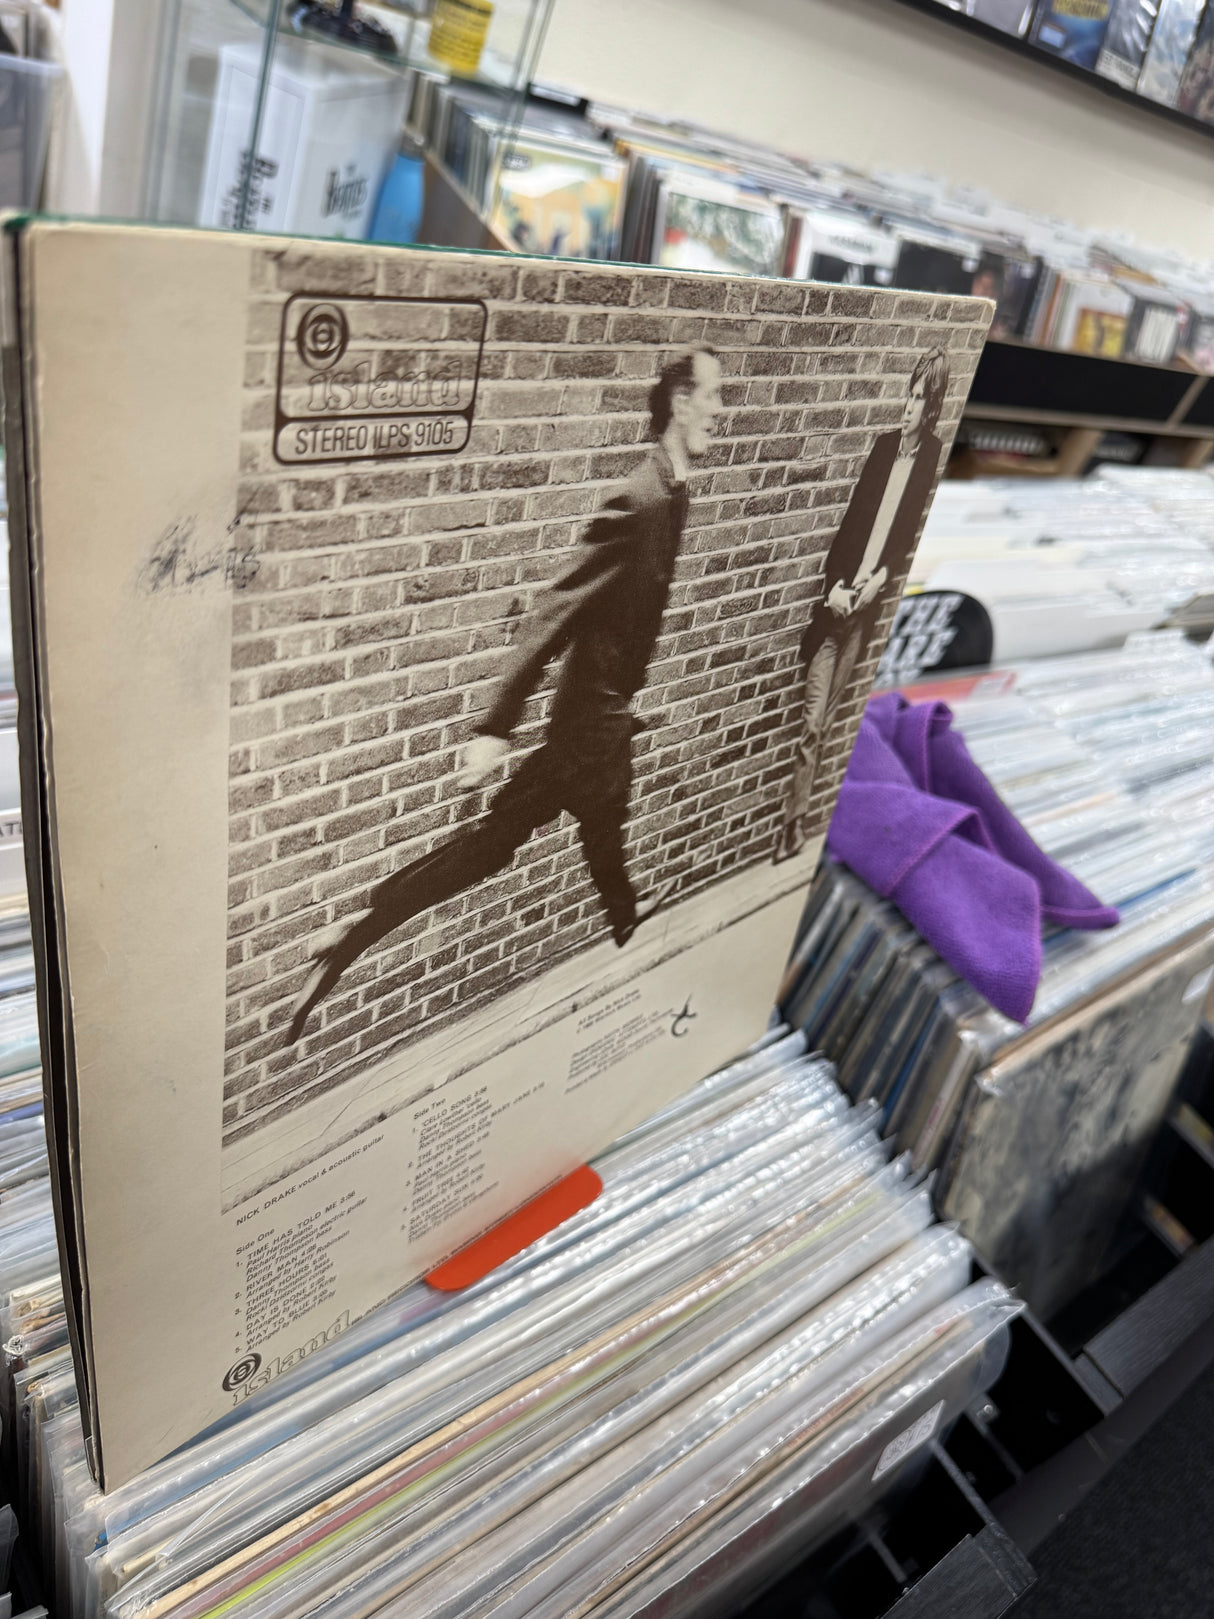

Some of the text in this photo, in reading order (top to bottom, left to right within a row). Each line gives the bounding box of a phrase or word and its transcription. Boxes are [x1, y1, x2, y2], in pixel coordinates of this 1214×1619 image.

[295, 420, 454, 455] STEREO ILPS 9105
[235, 1134, 384, 1225] NICK DRAKE vocal & acoustic guitar
[235, 1228, 274, 1255] Side One
[245, 1252, 277, 1275] Richard
[279, 1227, 318, 1254] Thompson
[319, 1210, 345, 1229] electric
[245, 1224, 313, 1268] Paul Harris piano
[246, 1242, 269, 1259] TIME
[272, 1228, 293, 1245] HAS
[297, 1211, 321, 1229] TOLD
[324, 1201, 336, 1213] ME
[245, 1262, 272, 1282] Danny
[274, 1237, 314, 1264] Thompson
[245, 1271, 282, 1299] Arranged
[293, 1252, 314, 1268] Harry
[315, 1230, 349, 1254] Robinson
[245, 1270, 272, 1291] RIVER
[276, 1255, 297, 1272] MAN
[245, 1295, 271, 1315] Danny
[273, 1269, 312, 1296] Thompson
[246, 1284, 274, 1306] THREE
[278, 1263, 309, 1287] HOURS
[245, 1312, 266, 1330] DAY
[269, 1304, 279, 1315] IS
[282, 1286, 306, 1306] DONE
[246, 1326, 268, 1345] WAY
[273, 1316, 285, 1328] TO
[287, 1299, 309, 1318] BLUE
